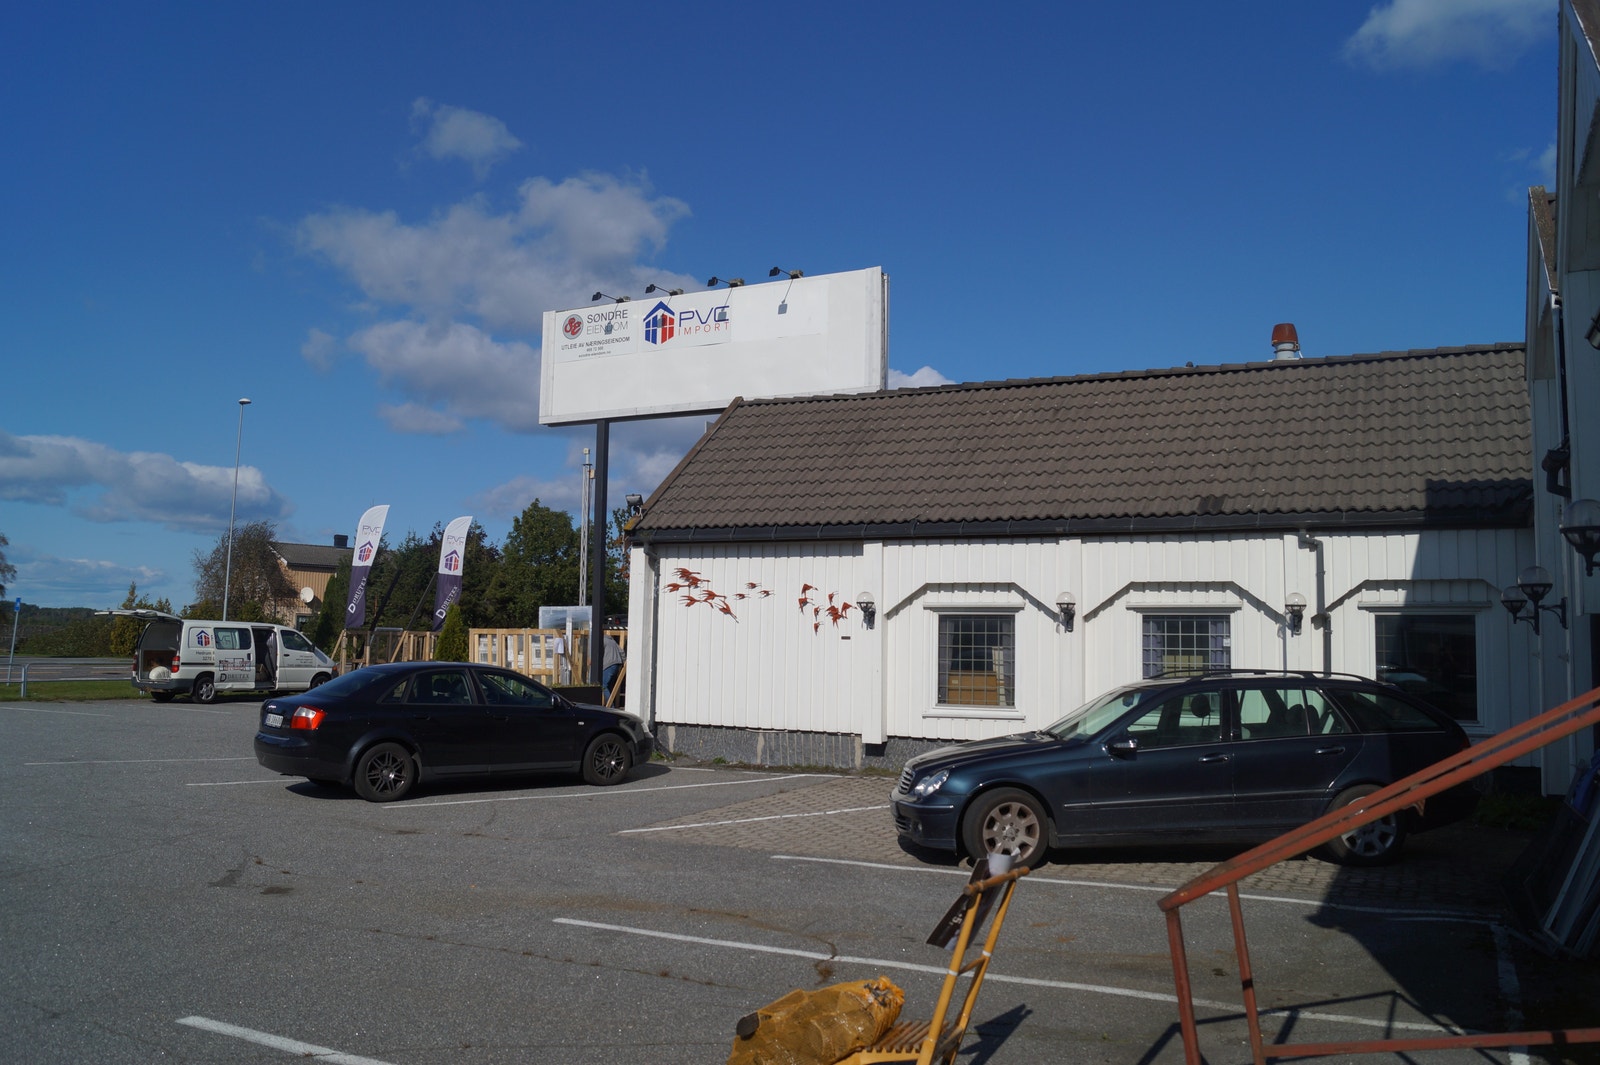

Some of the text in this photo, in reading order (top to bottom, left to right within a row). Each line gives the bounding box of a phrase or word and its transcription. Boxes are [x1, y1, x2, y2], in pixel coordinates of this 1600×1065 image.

[586, 309, 629, 324] SØNDRE
[679, 305, 730, 328] PVC
[586, 321, 629, 336] EIENOM
[678, 322, 730, 336] IMPORT
[362, 525, 382, 534] PVC
[446, 535, 465, 544] PVC
